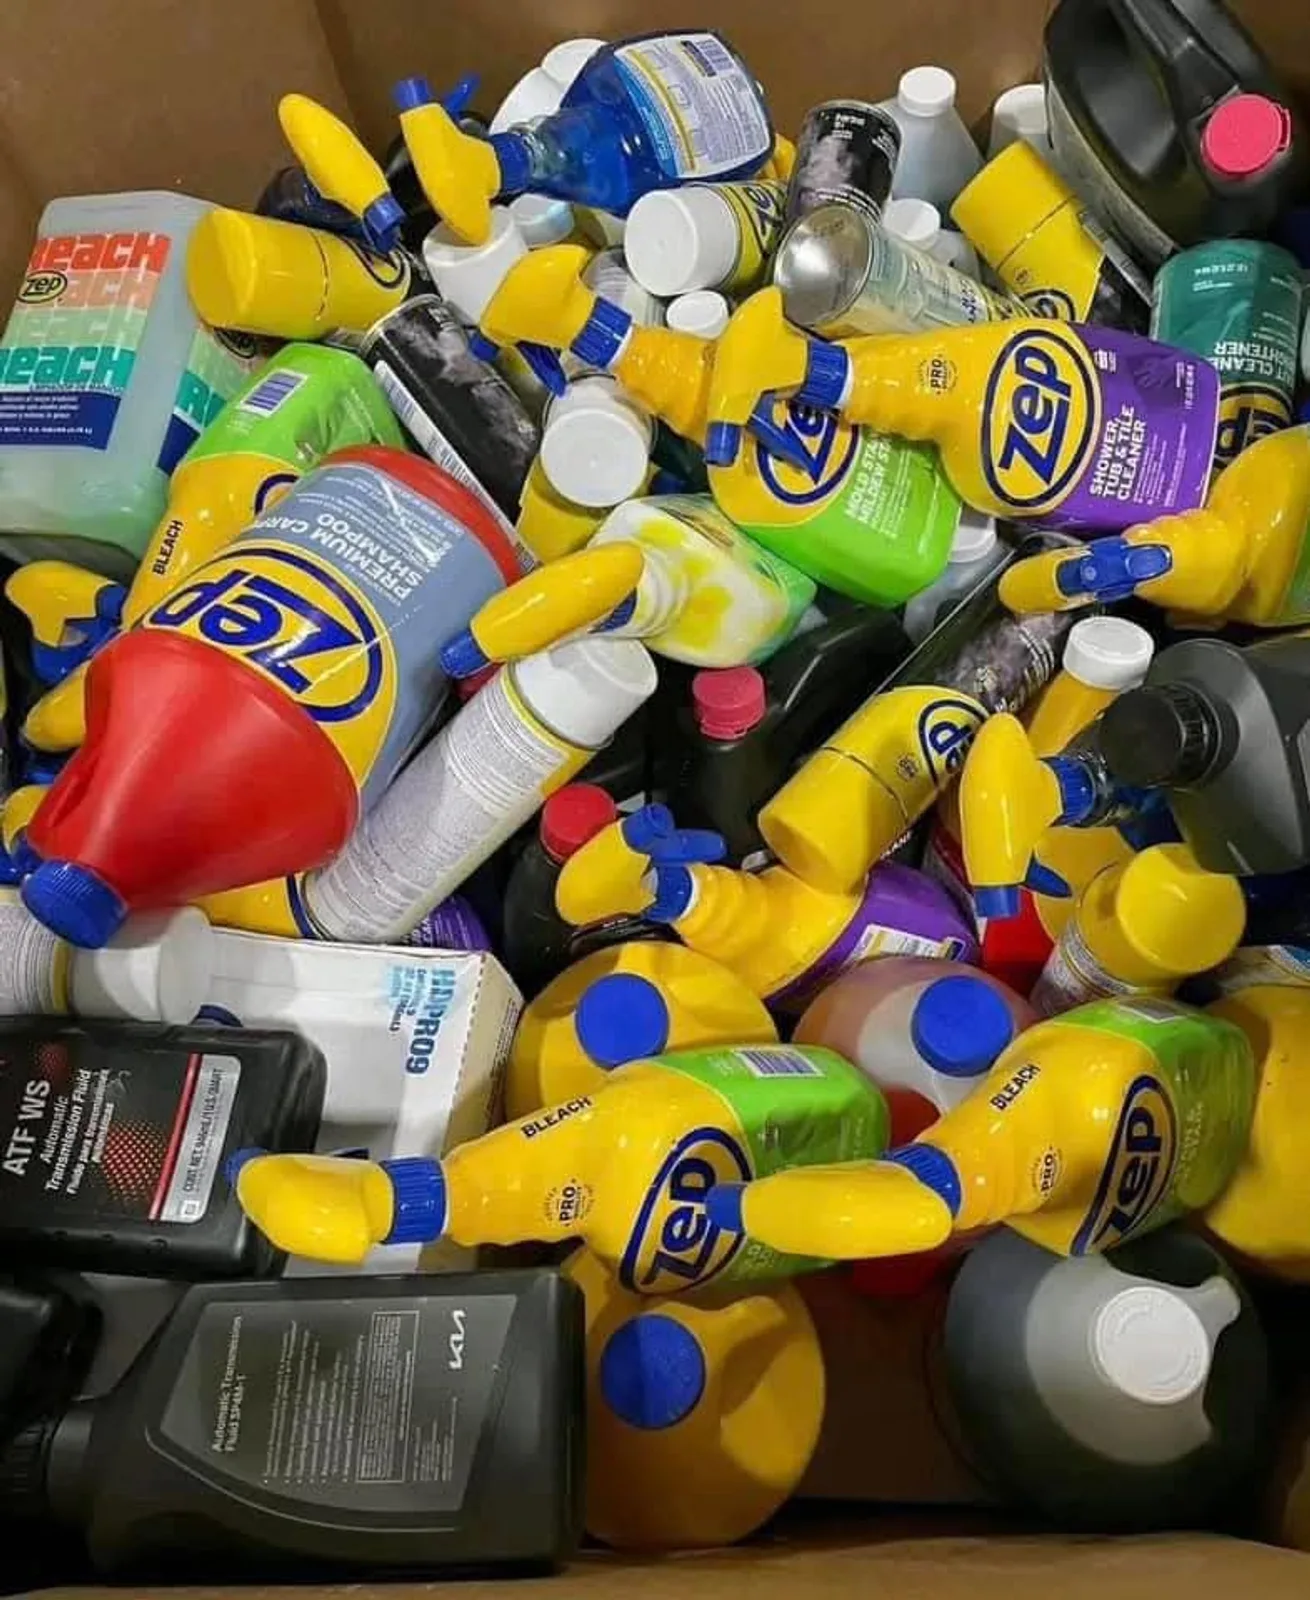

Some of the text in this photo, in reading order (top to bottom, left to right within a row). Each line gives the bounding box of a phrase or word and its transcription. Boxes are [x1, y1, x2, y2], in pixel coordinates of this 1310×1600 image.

[1102, 404, 1135, 497] TUB & TILE
[1116, 419, 1147, 500] CLEANER
[152, 519, 184, 575] BLEACH
[310, 524, 414, 602] PREMIUM
[319, 512, 424, 589] SHAMPOO
[520, 1096, 593, 1139] BLEACH
[990, 1063, 1041, 1111] BLEACH
[1, 1076, 52, 1177] ATF WS
[39, 1094, 69, 1164] Automatic
[44, 1068, 92, 1192] Transmission Fluid
[210, 1390, 232, 1453] Automatic
